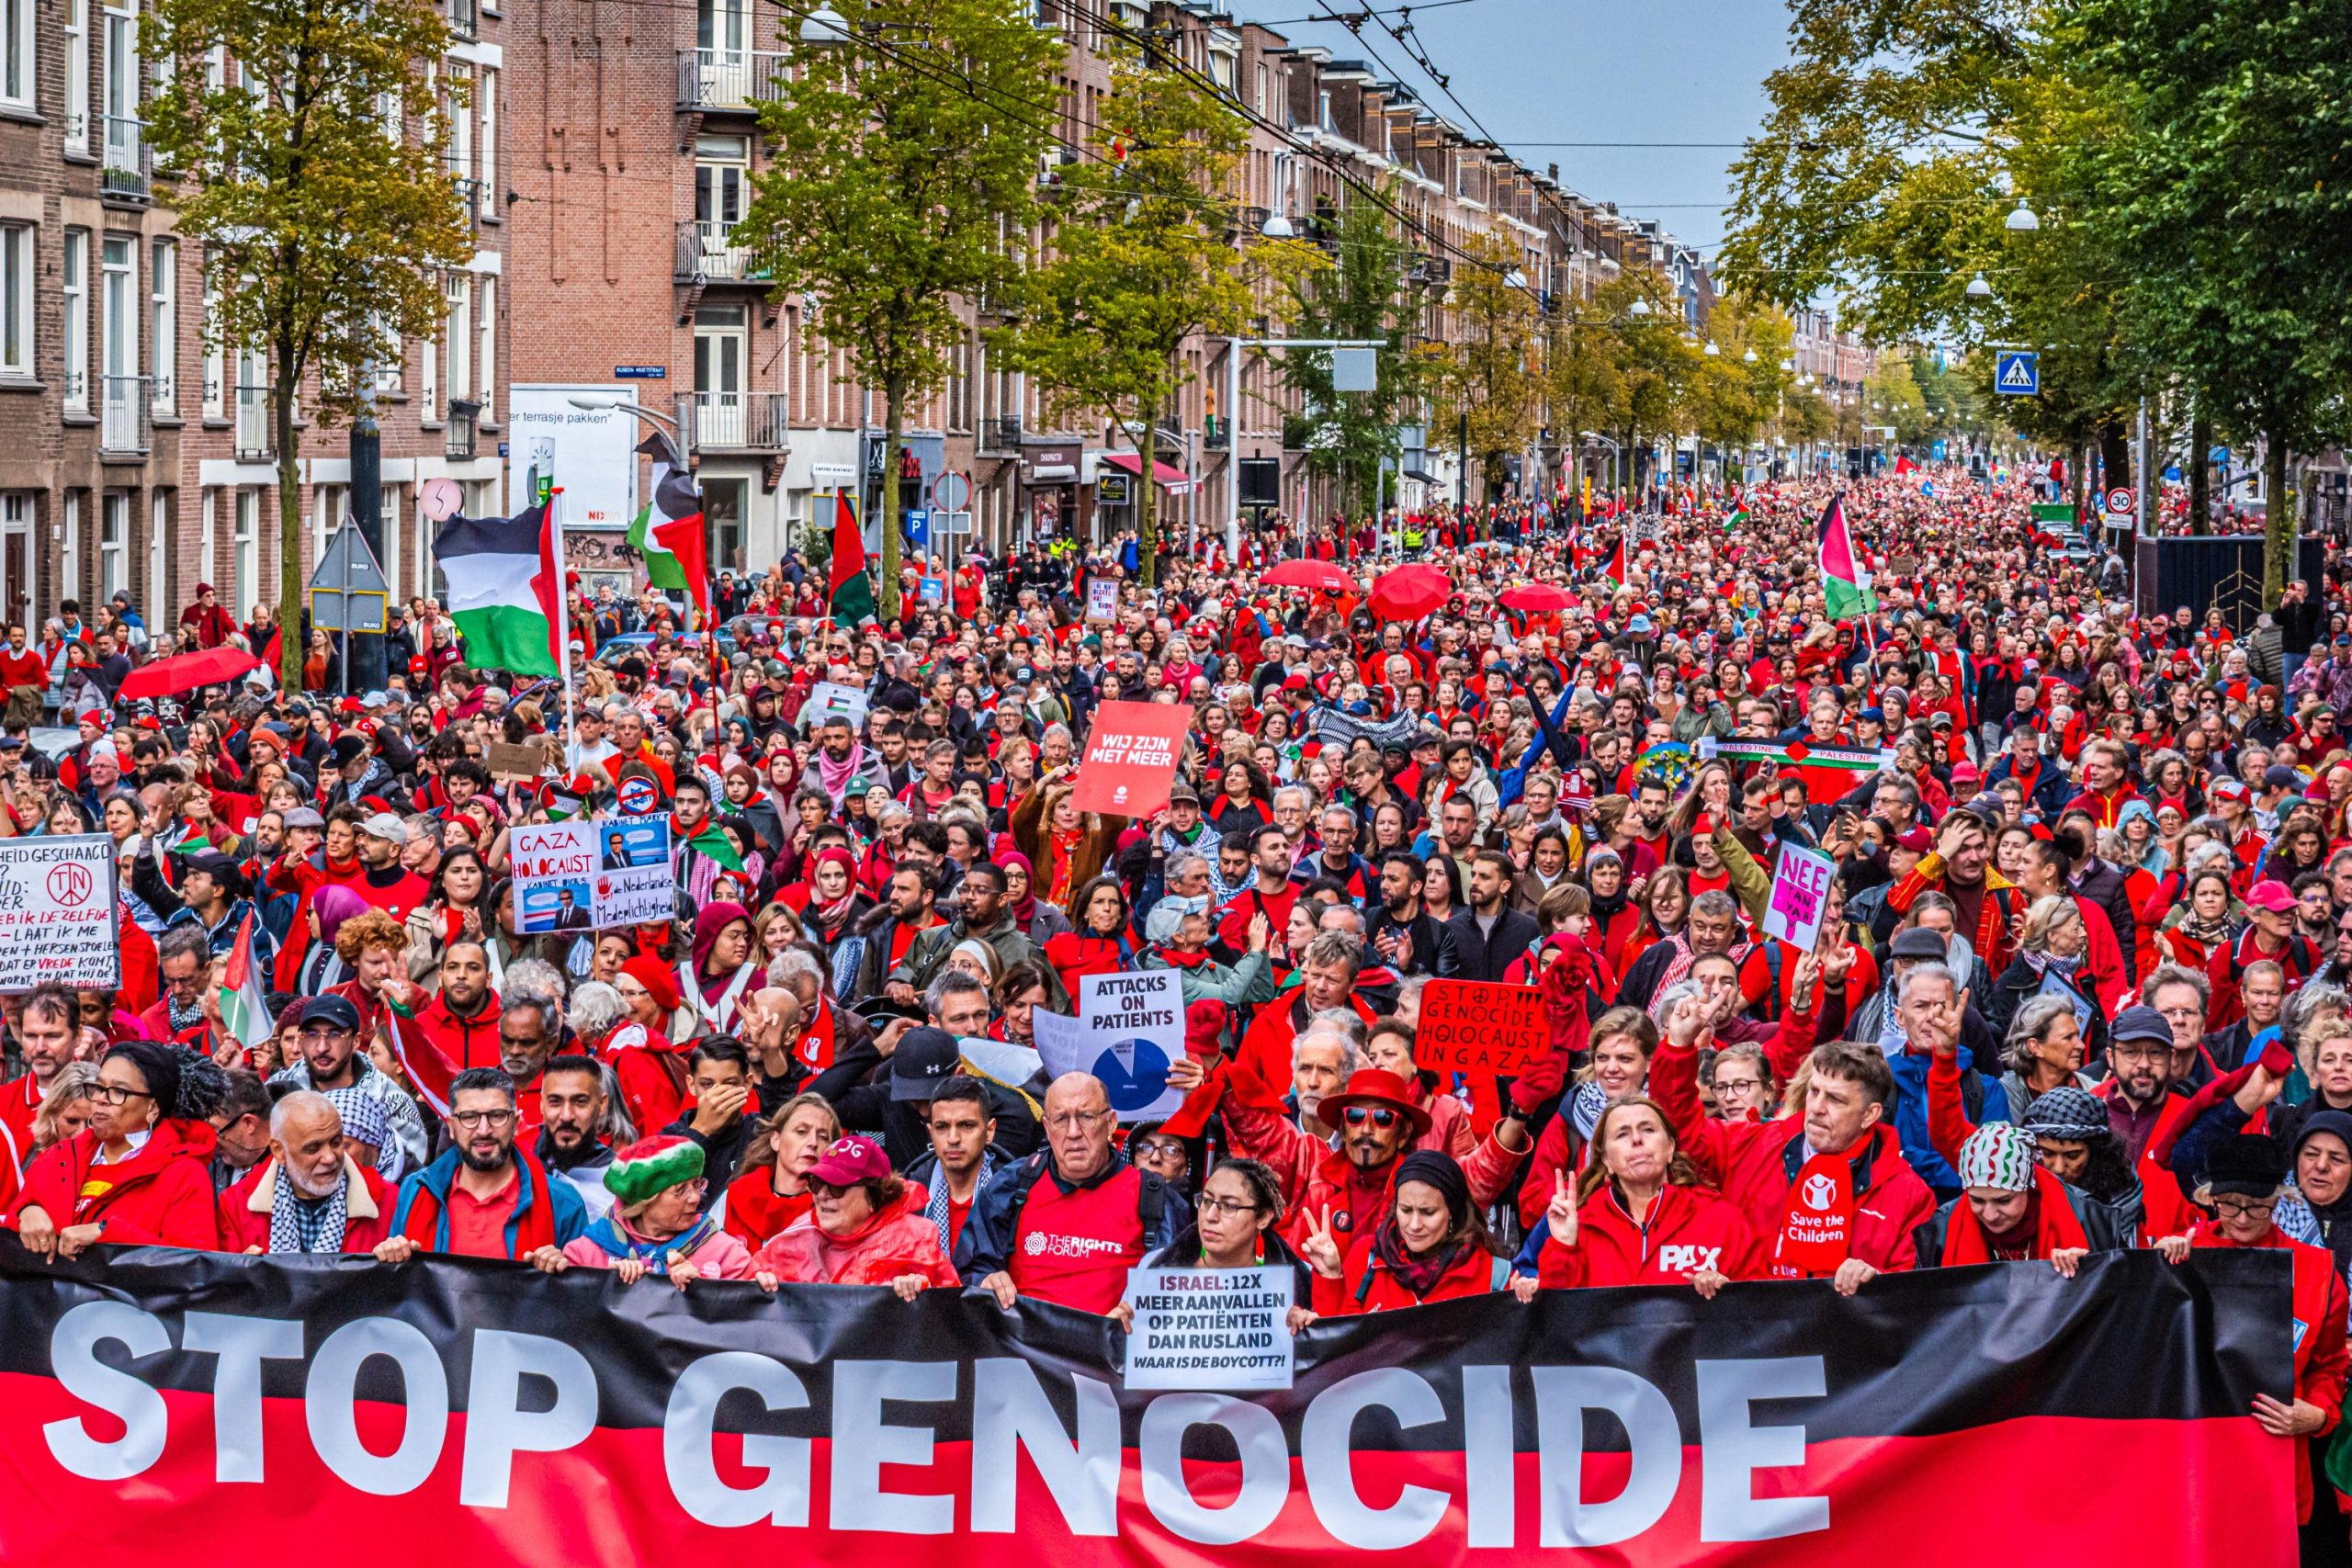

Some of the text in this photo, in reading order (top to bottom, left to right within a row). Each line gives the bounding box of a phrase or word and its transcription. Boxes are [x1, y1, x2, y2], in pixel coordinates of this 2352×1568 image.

[524, 412, 564, 425] terrasje
[567, 412, 613, 425] pakken"
[2113, 496, 2130, 507] 30
[912, 520, 922, 534] P
[1102, 733, 1171, 751] WIJ ZIJN
[1090, 748, 1172, 767] MET MEER
[1722, 743, 1873, 762] PALESTINE PALESTINE
[519, 831, 581, 852] GAZA
[513, 854, 594, 880] HOLOCAUST
[1781, 849, 1827, 897] NEE
[623, 872, 673, 893] Nederlandse
[1788, 886, 1812, 908] TAN
[596, 895, 674, 927] Medeplichtigheid
[14, 927, 54, 942] LAAT
[77, 925, 99, 938] ME
[38, 956, 76, 970] VREDE
[37, 971, 52, 980] EN
[55, 969, 76, 980] DAT
[1096, 976, 1168, 997] ATTACKS
[1121, 995, 1146, 1011] ON
[1092, 1010, 1174, 1031] PATIENTS
[1426, 1001, 1535, 1028] GENOCIDE
[1421, 1023, 1545, 1051] HOLOCAUST
[1423, 1042, 1533, 1070] IN GAZA
[1790, 1211, 1845, 1228] Save the
[1788, 1225, 1844, 1244] Children
[1047, 1245, 1089, 1258] FORUM
[1659, 1244, 1723, 1272] PAX
[1159, 1273, 1262, 1292] ISRAEL: 12X
[1136, 1292, 1286, 1311] MEER AANVALLEN
[1148, 1310, 1272, 1330] OP PATIËNTEN
[1148, 1333, 1272, 1349] DAN RUSLAND
[1134, 1354, 1286, 1369] WAAR IS DE BOYCOTT?!
[42, 1299, 1830, 1551] STOP GENOCIDE
